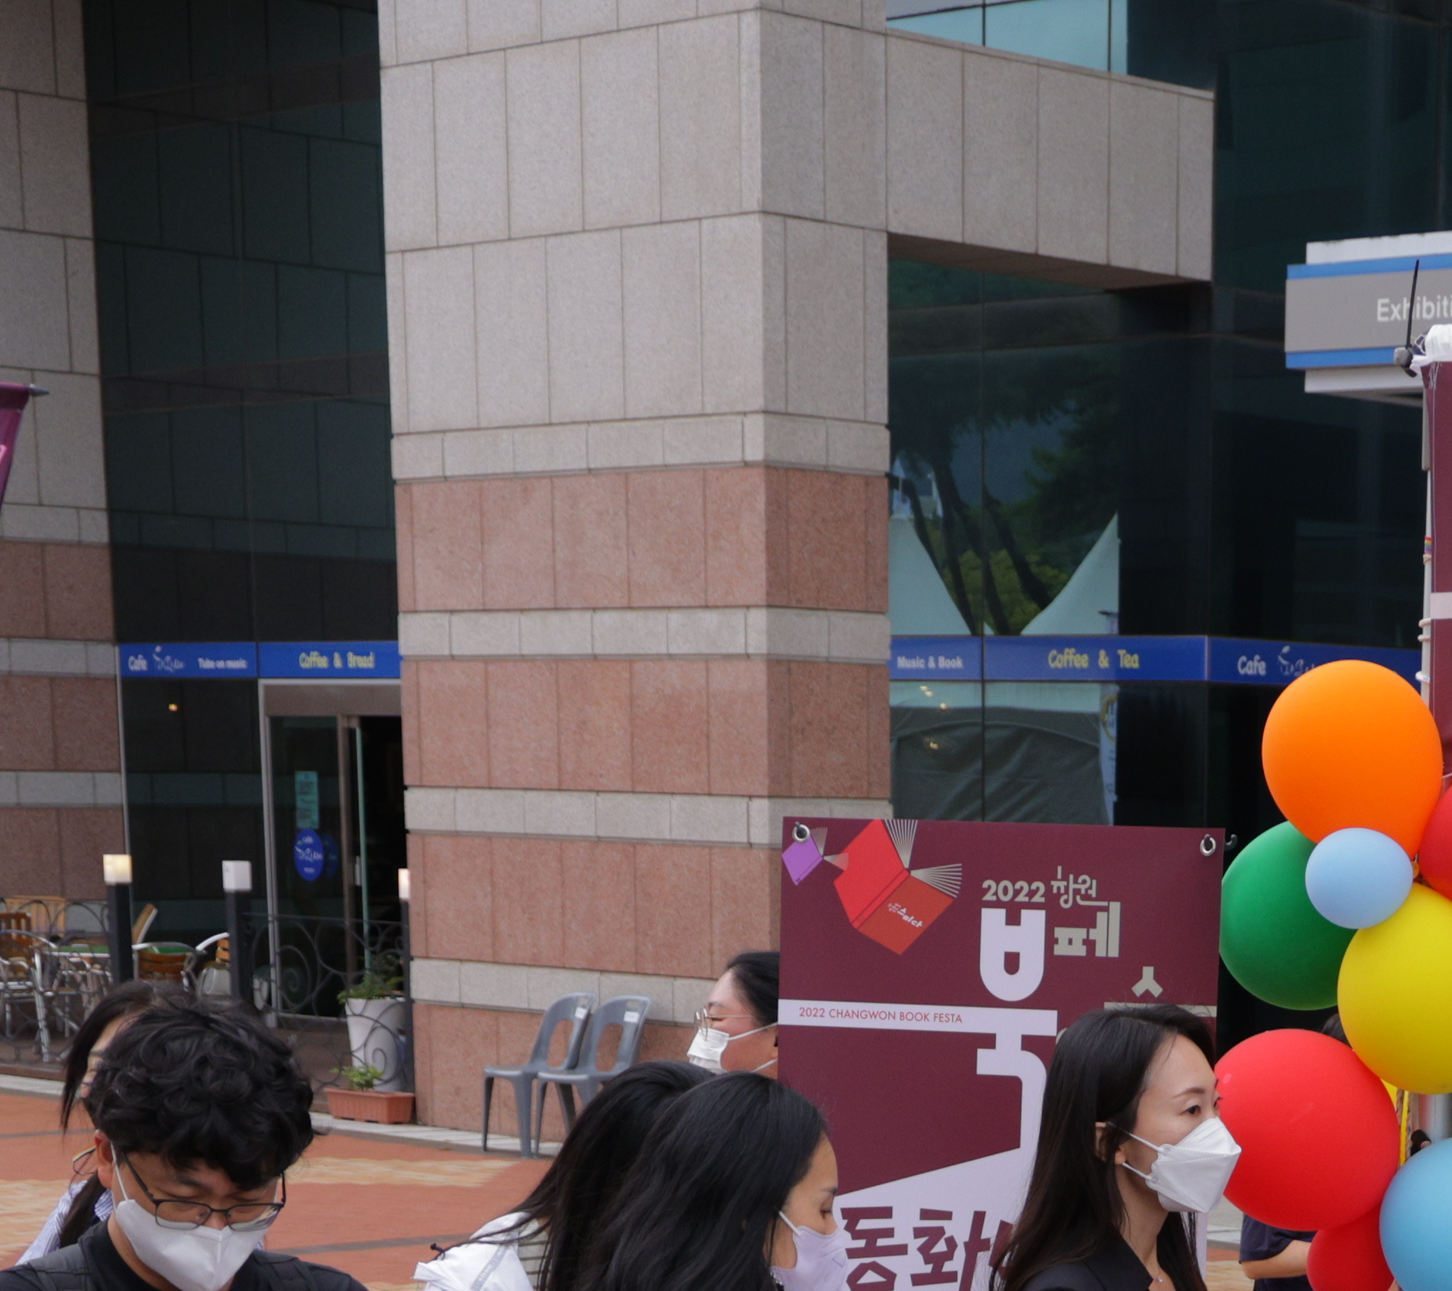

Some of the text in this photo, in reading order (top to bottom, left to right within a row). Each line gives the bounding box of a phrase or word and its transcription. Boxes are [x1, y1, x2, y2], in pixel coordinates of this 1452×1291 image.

[299, 652, 328, 669] Coffee
[897, 655, 926, 670] Music
[938, 655, 964, 670] Book
[1048, 648, 1140, 670] Coffee & Tea
[1237, 655, 1267, 677] Cafe
[981, 879, 1046, 903] 2022
[798, 1007, 964, 1025] 2022 CHANGWON BOOK FESTA
